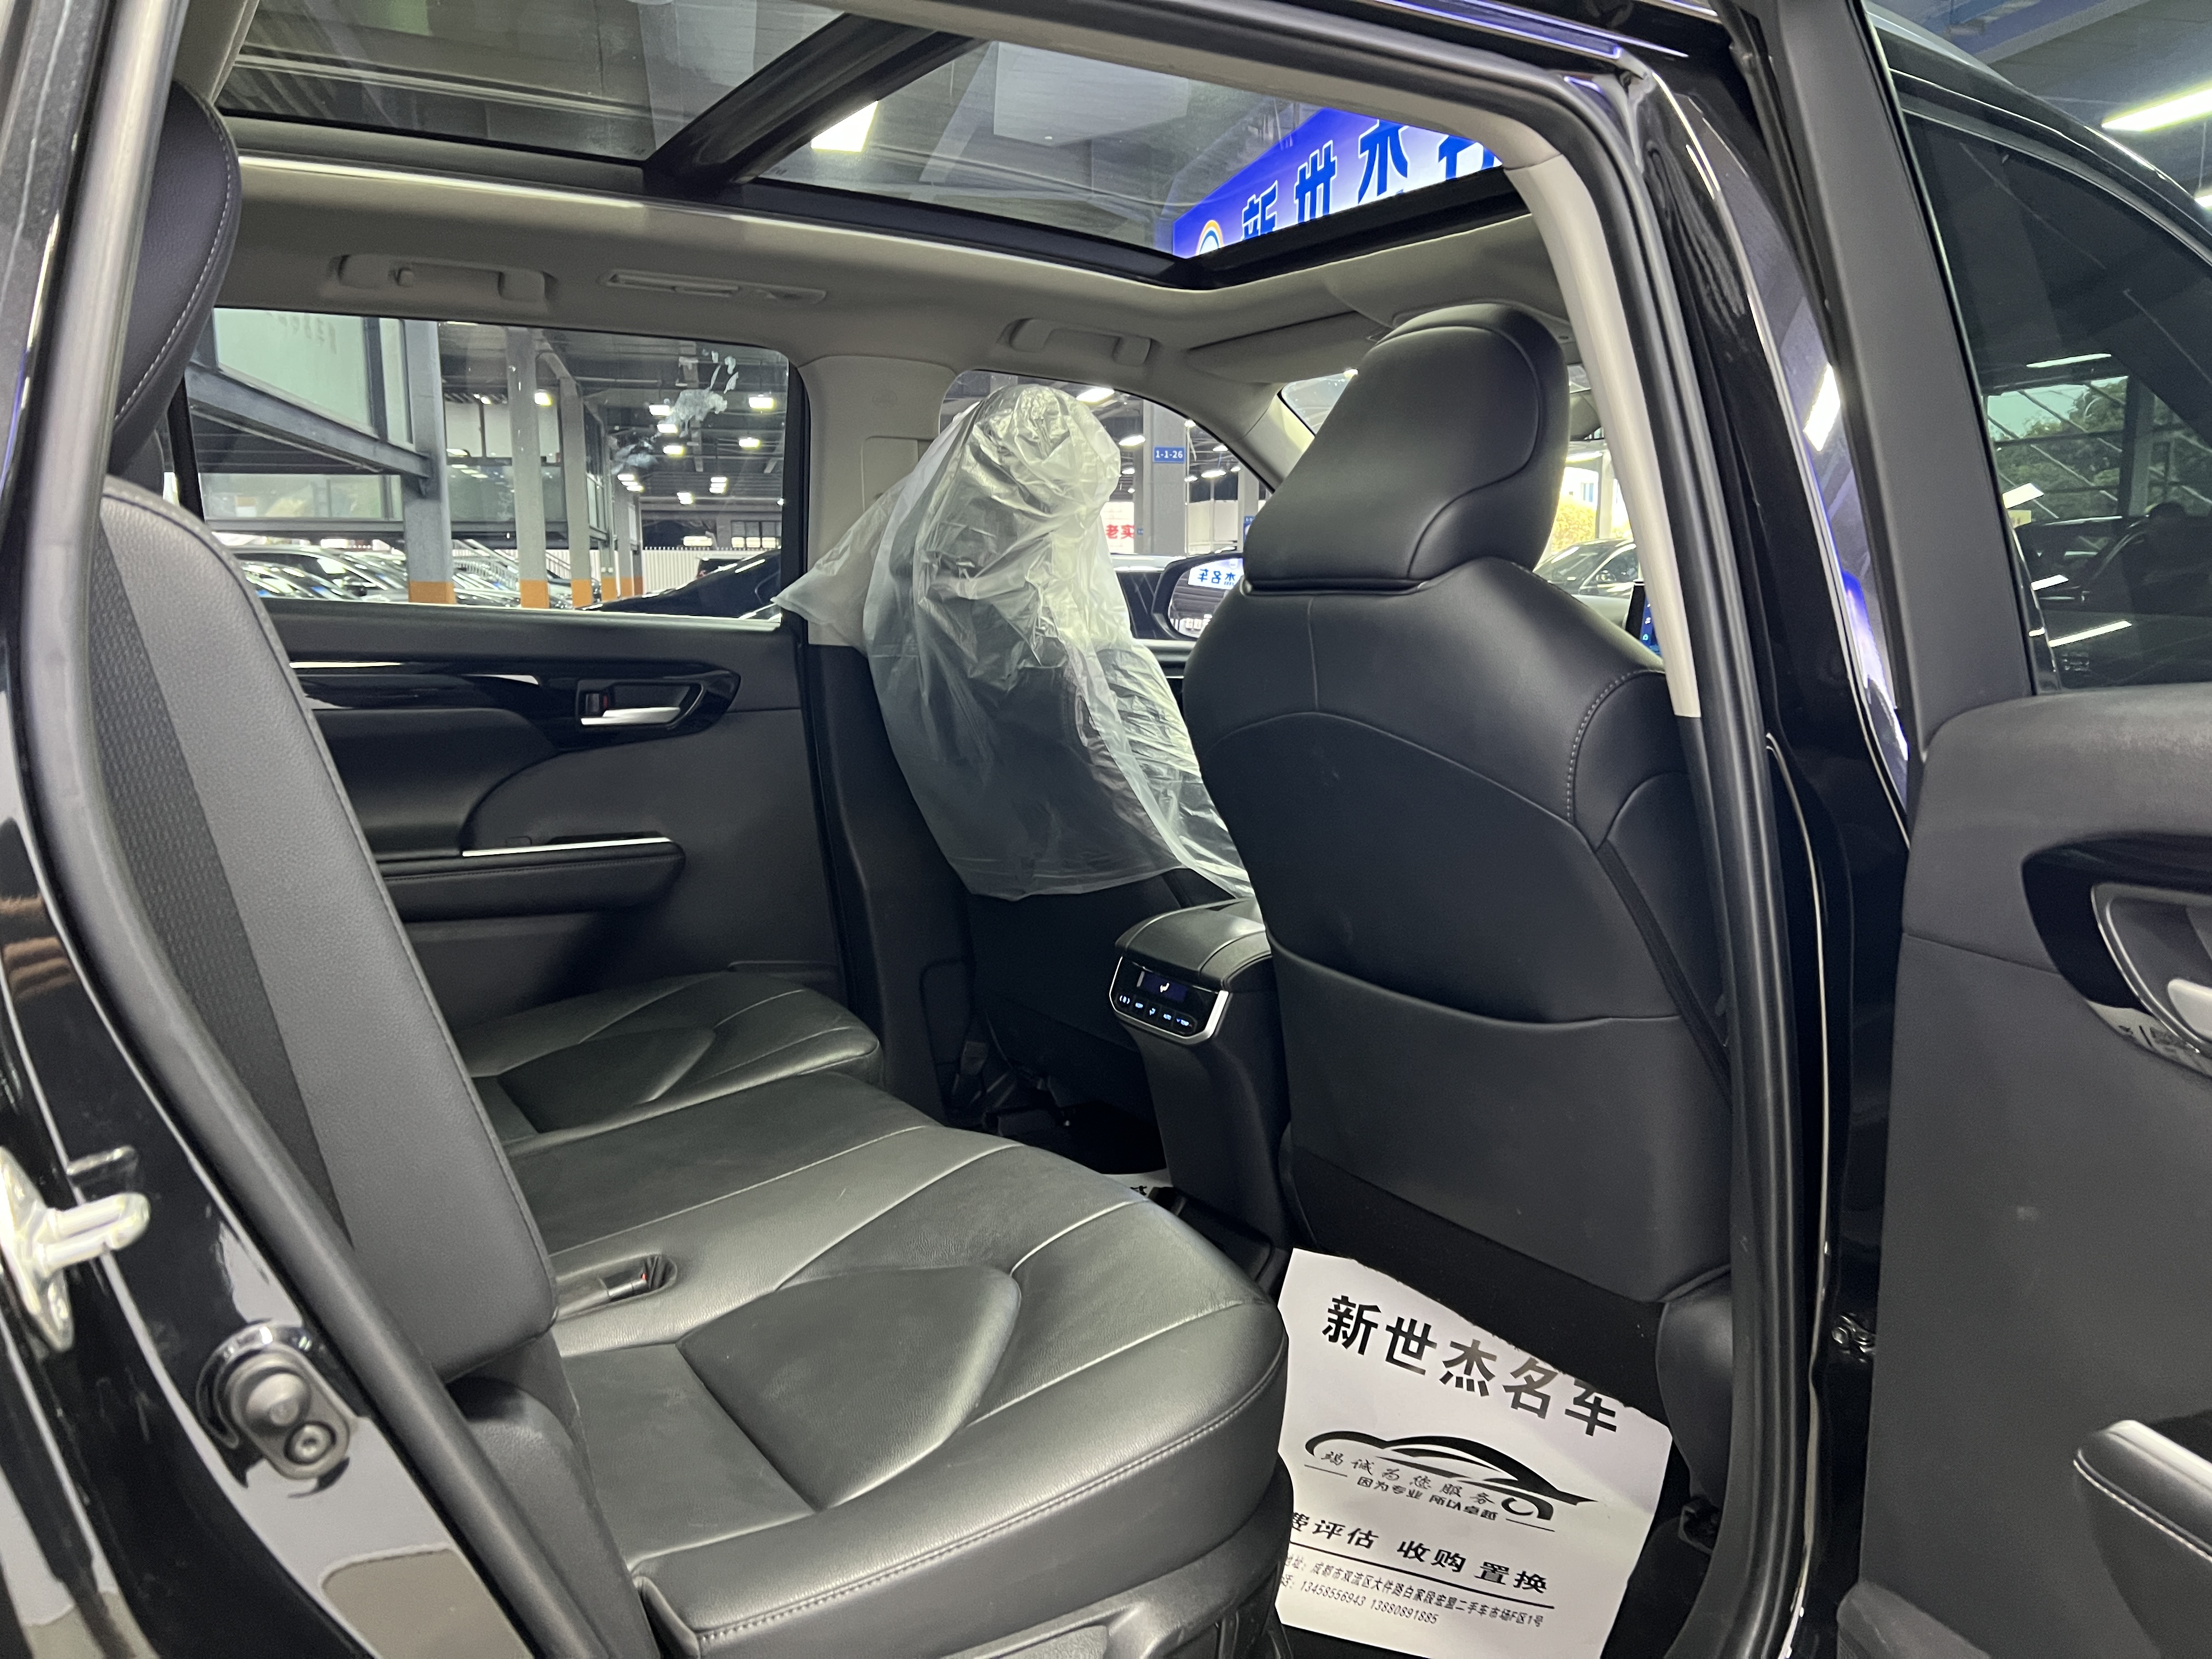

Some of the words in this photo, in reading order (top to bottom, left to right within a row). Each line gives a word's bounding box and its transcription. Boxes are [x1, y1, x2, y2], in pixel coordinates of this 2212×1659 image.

[1155, 450, 1183, 459] 1-1-26
[1322, 1295, 1617, 1437] 新世杰名车
[1357, 1476, 1424, 1500] 因为专业
[1428, 1494, 1498, 1521] 所以卓越
[1397, 1540, 1467, 1572] 收购
[1474, 1561, 1547, 1594] 置换
[1370, 1599, 1439, 1624] 13880891885
